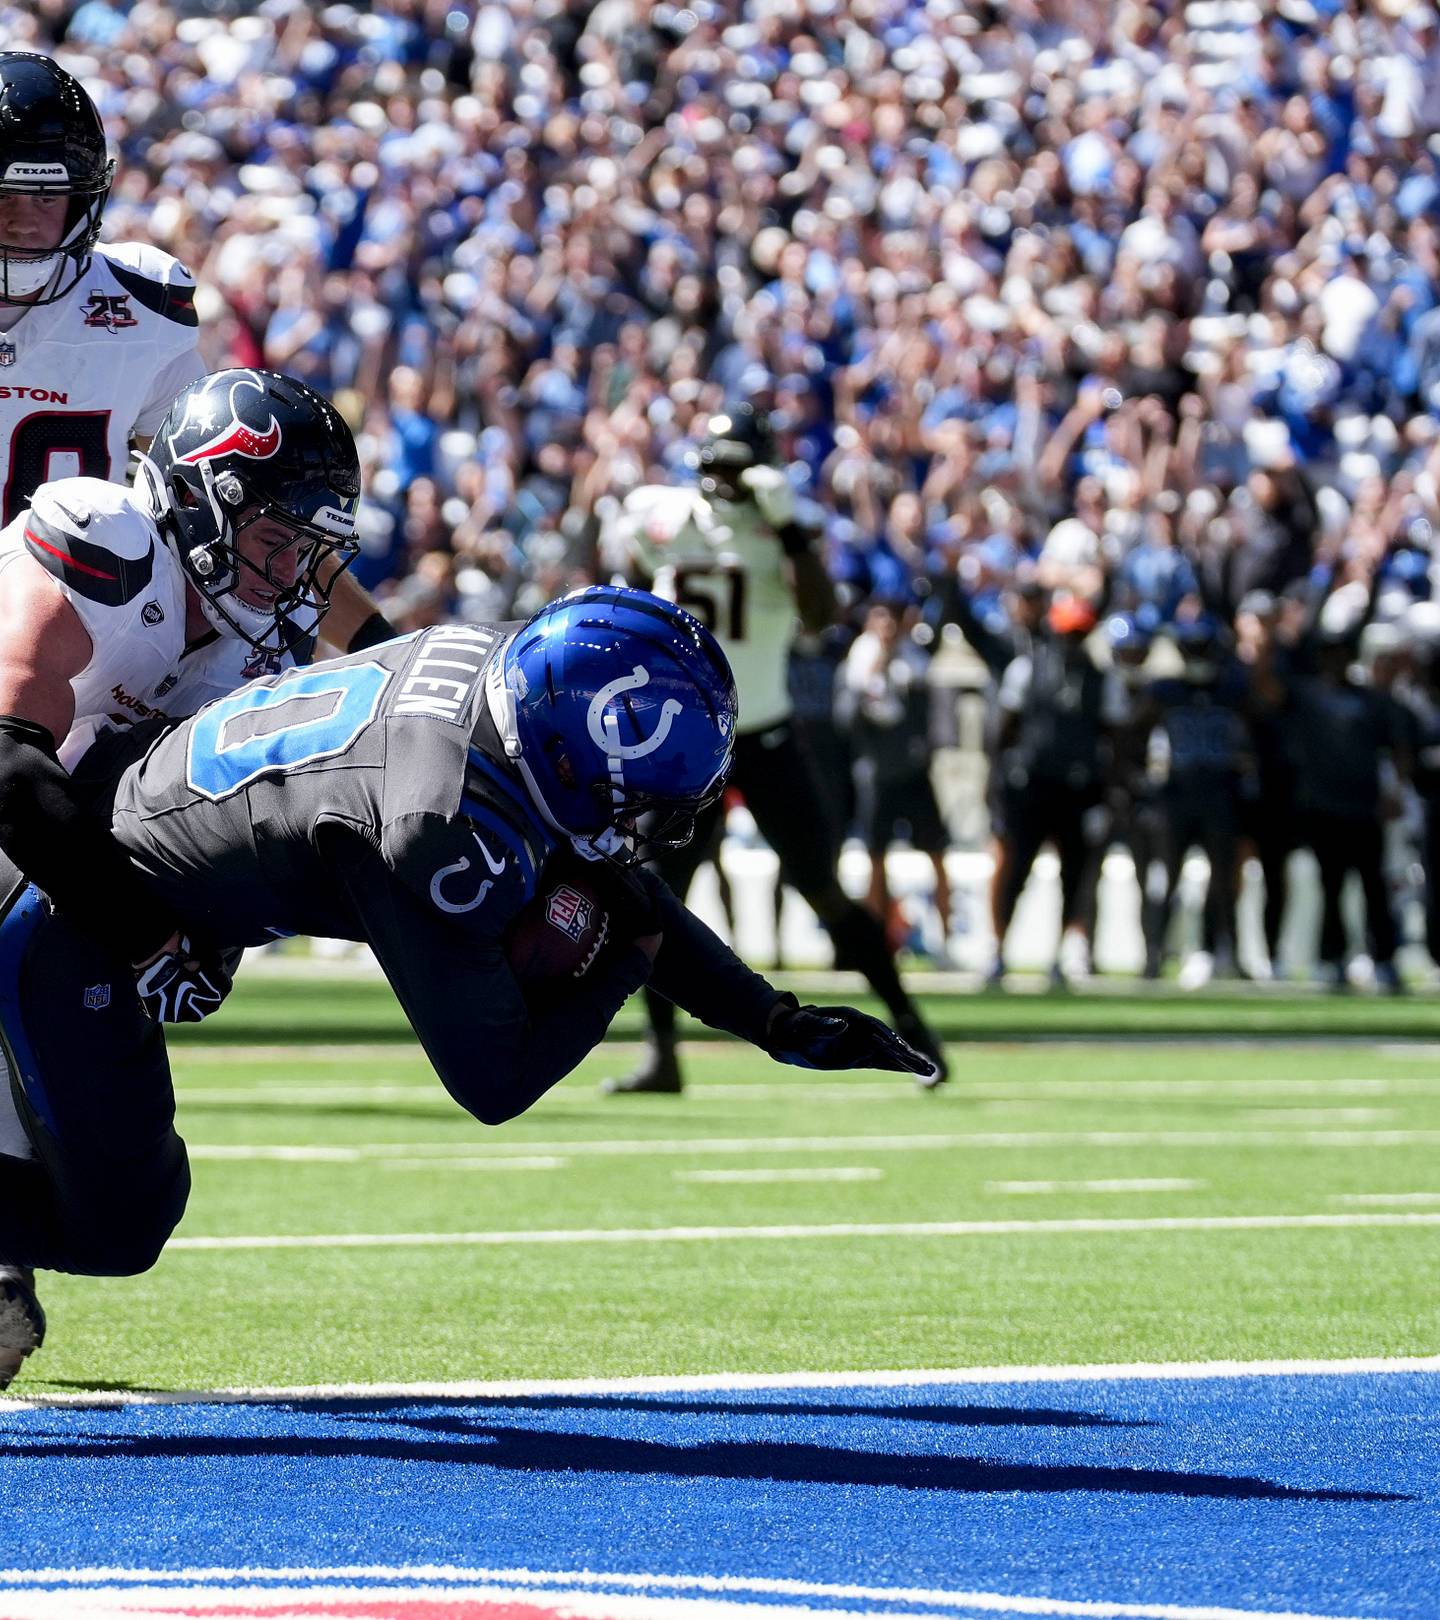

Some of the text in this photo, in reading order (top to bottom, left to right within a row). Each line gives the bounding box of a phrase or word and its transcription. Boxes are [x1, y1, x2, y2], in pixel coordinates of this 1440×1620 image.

[13, 167, 63, 175] TEXANS
[87, 294, 133, 321] 25
[673, 562, 747, 643] 51
[393, 625, 495, 720] ALLEN
[186, 628, 424, 803] 0
